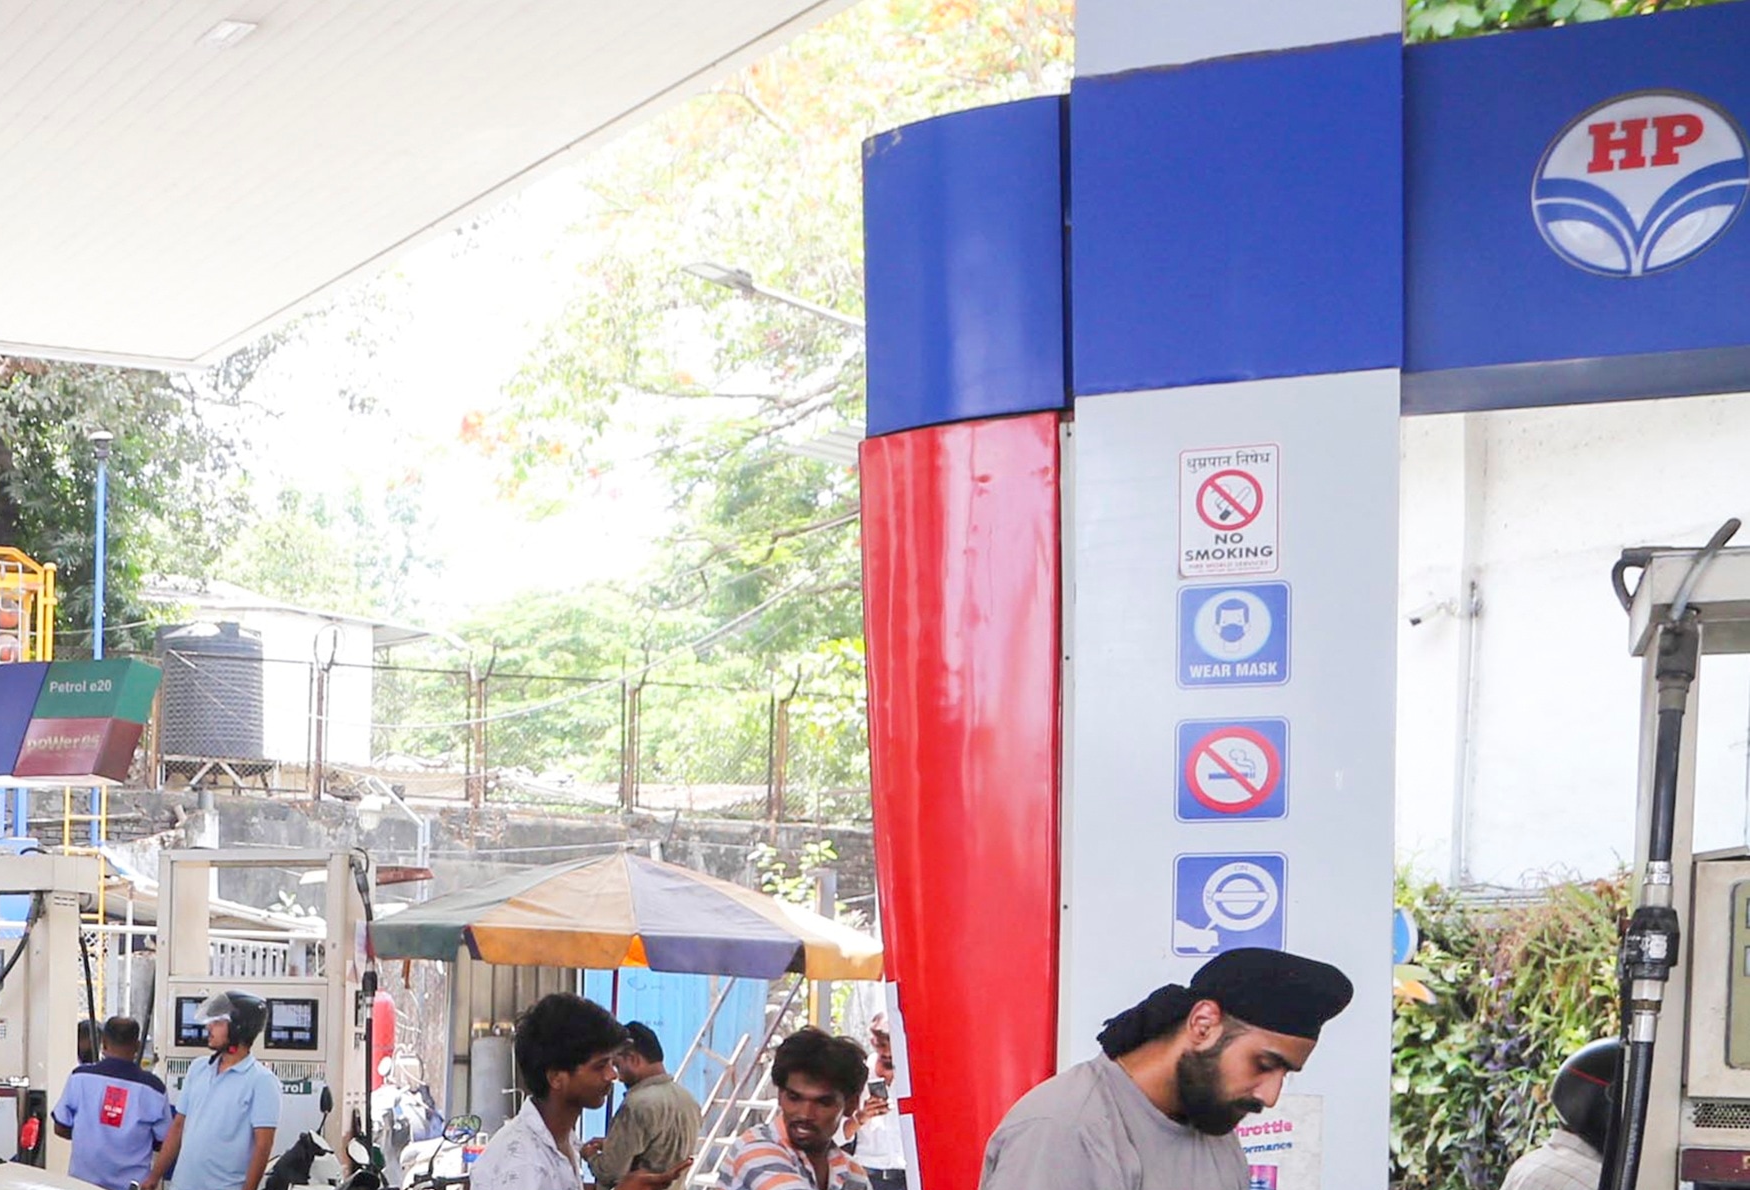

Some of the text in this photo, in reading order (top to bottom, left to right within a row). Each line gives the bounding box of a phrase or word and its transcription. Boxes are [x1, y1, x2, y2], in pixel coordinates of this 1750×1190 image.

[1587, 113, 1704, 175] HP
[1214, 532, 1243, 546] NO
[1184, 544, 1274, 562] SMOKING
[1190, 660, 1278, 679] WEAR MASK
[50, 679, 112, 694] Petrol e20
